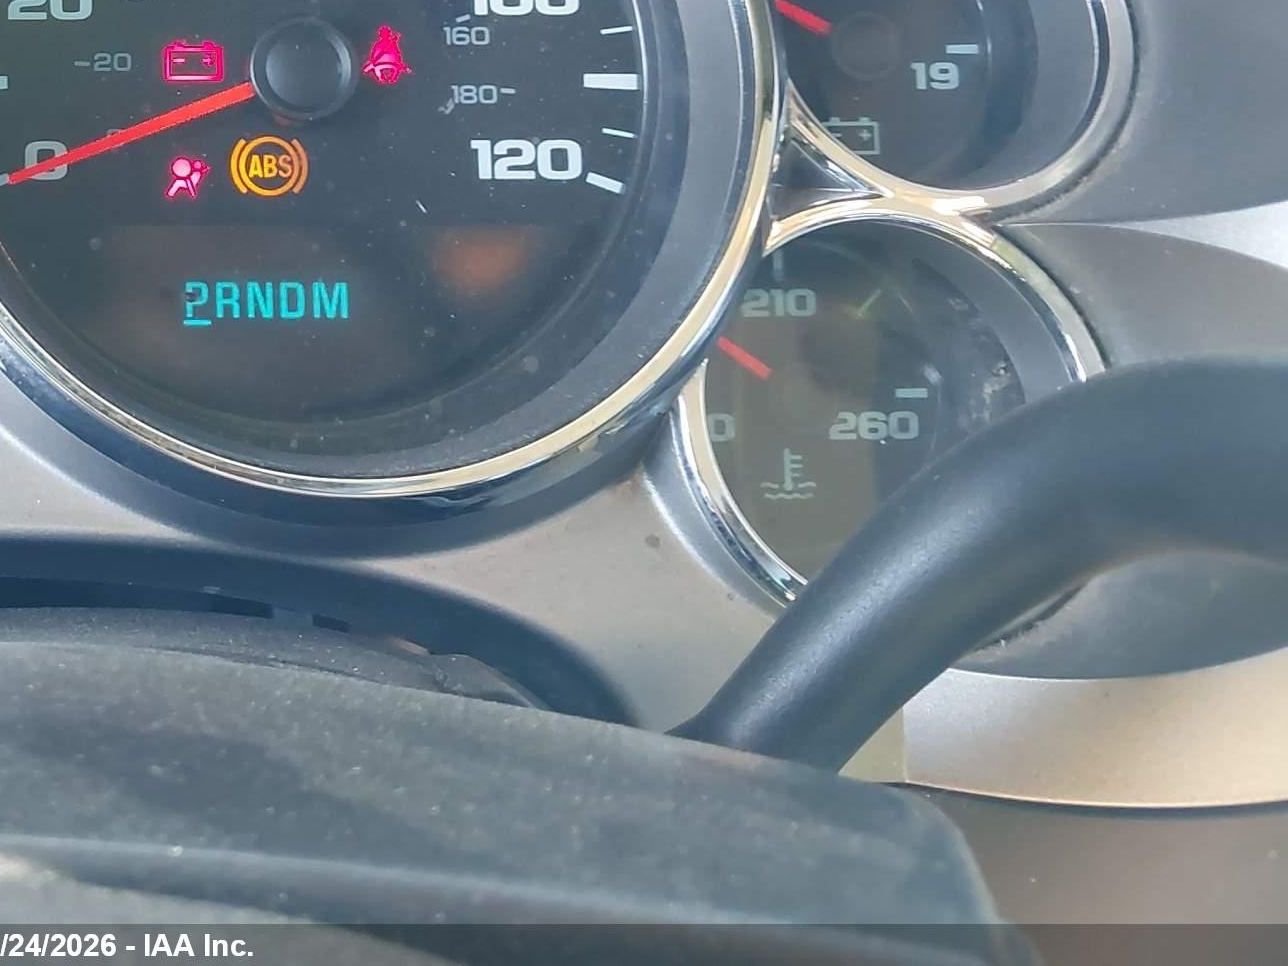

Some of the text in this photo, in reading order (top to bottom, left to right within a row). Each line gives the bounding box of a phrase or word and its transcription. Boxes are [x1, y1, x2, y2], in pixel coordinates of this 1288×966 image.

[443, 27, 490, 45] 160
[93, 53, 132, 71] 20
[910, 62, 960, 90] 19
[451, 85, 498, 104] 180
[24, 141, 68, 180] 0
[248, 155, 292, 178] ABS
[470, 139, 582, 179] 120
[742, 289, 816, 317] 210
[829, 411, 919, 440] 260
